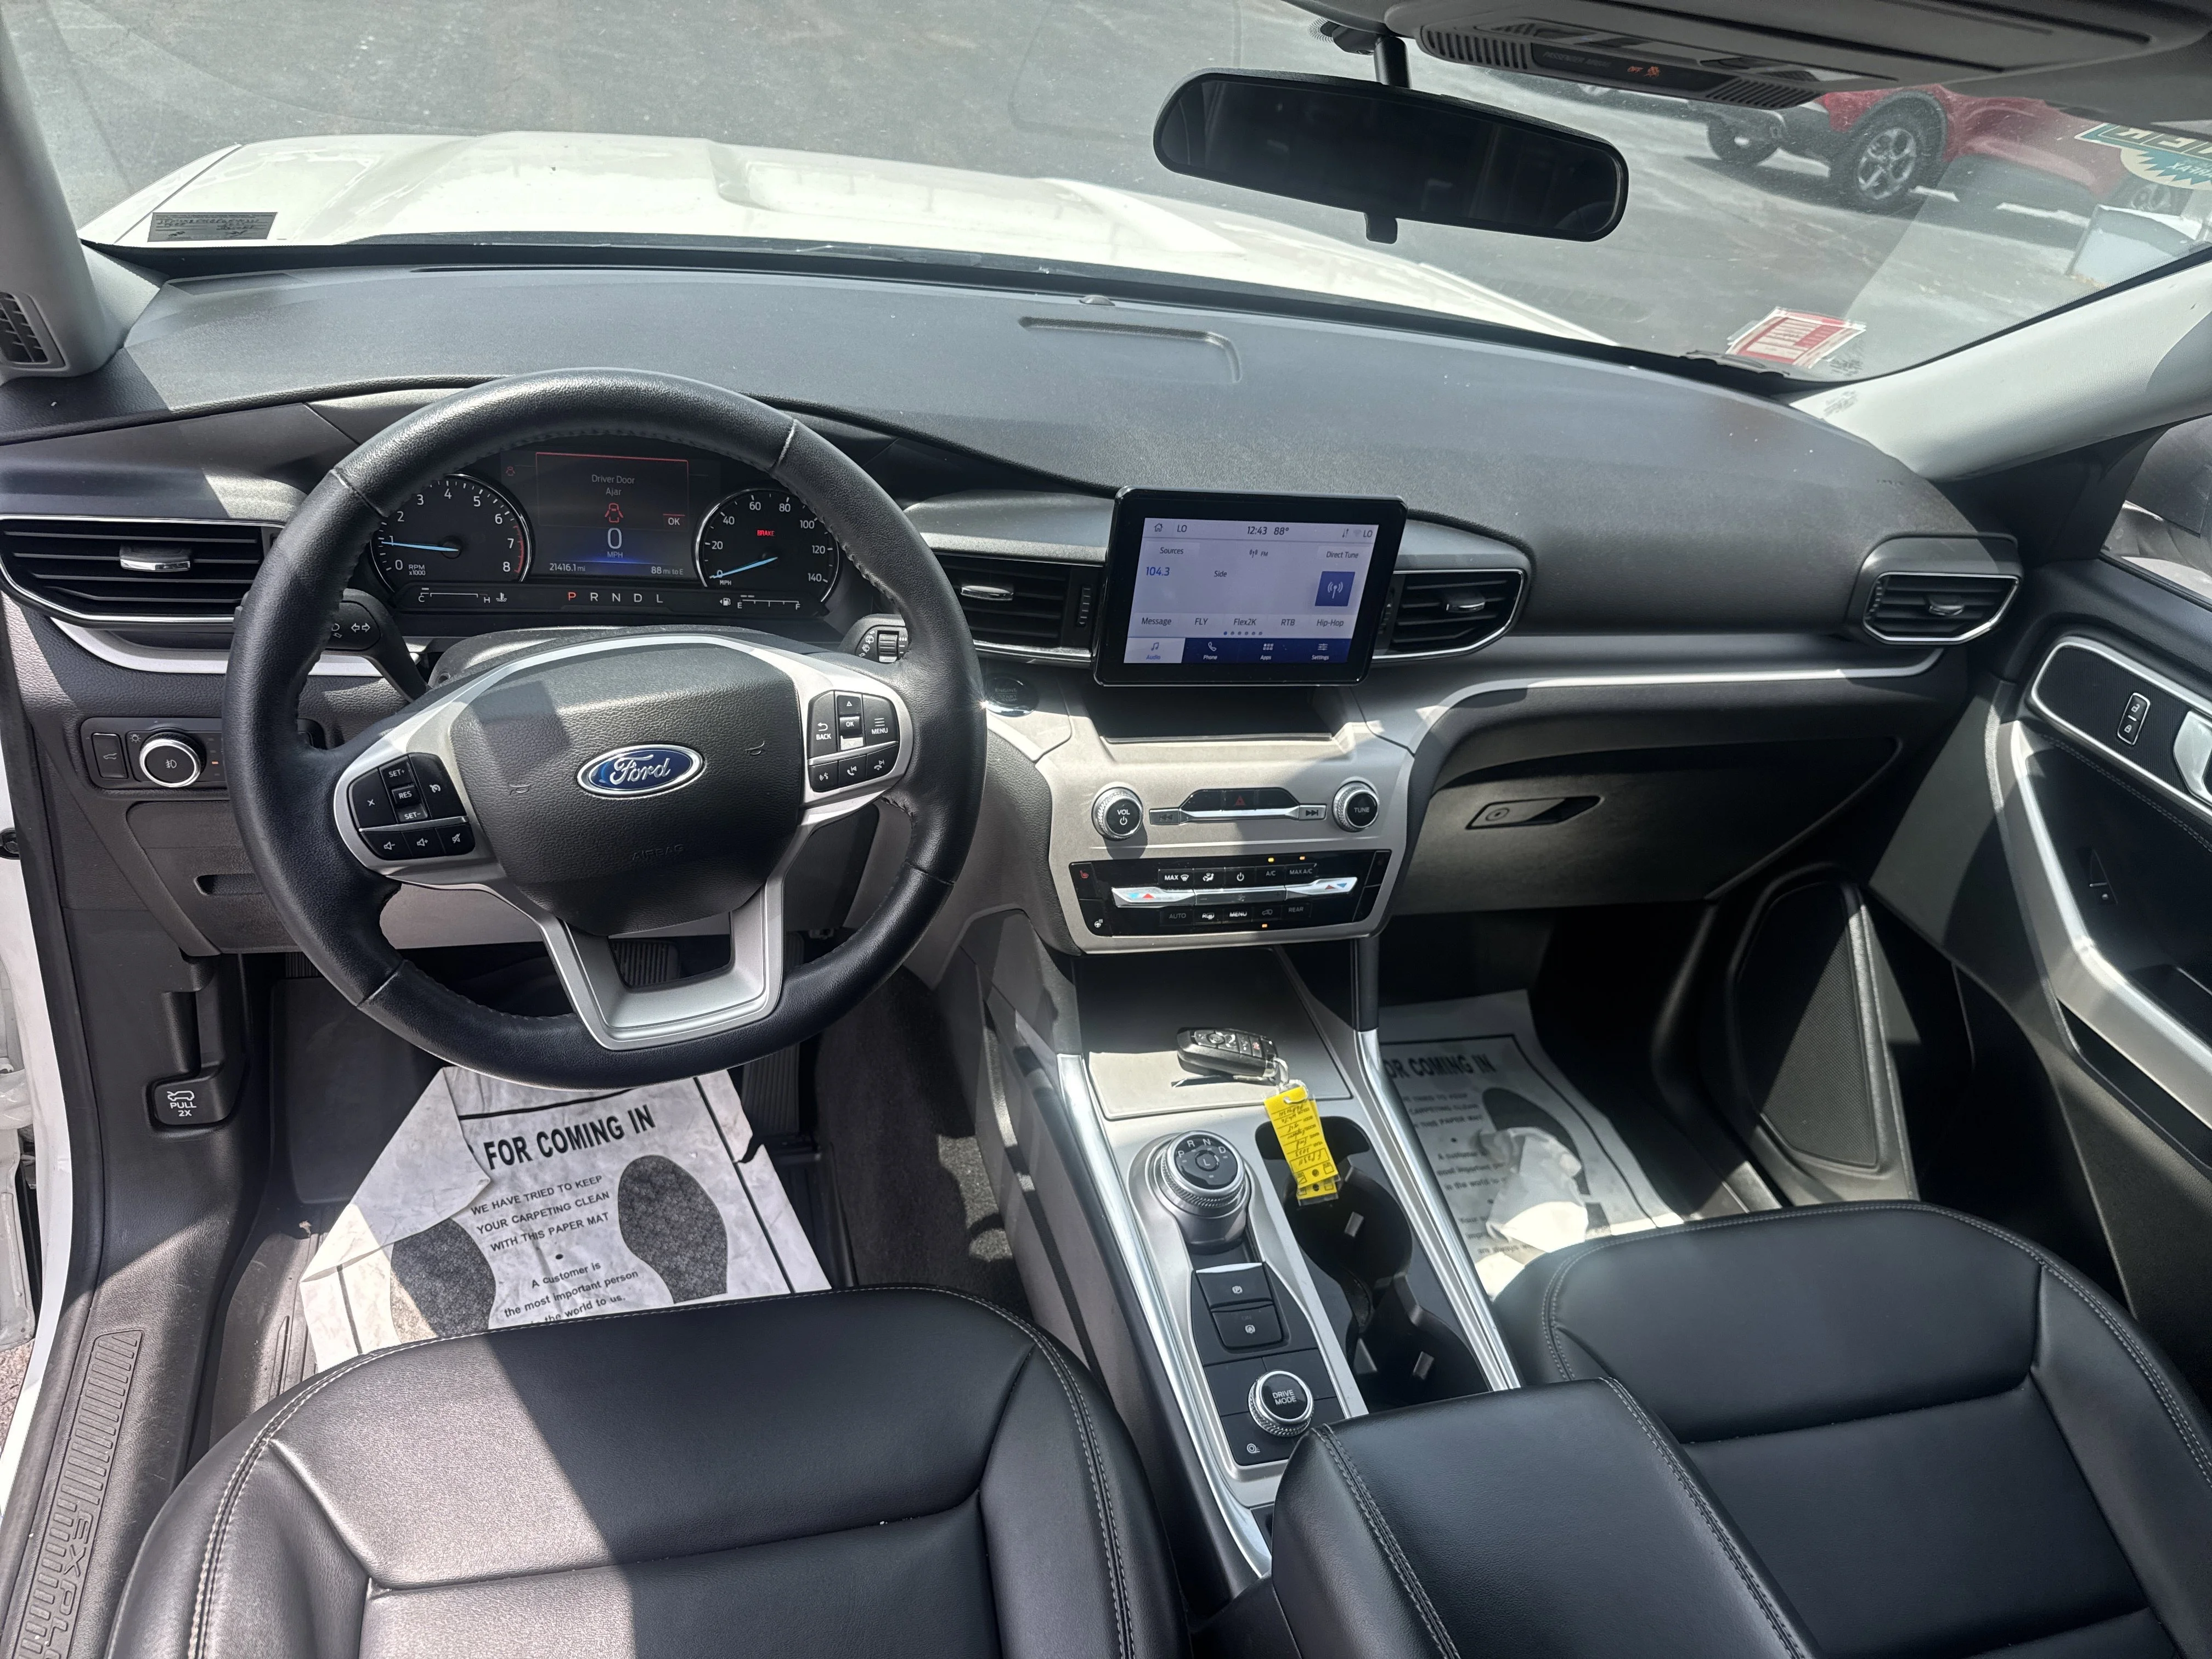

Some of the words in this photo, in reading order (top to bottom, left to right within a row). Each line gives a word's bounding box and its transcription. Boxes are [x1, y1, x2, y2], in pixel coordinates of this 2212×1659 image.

[592, 475, 614, 483] Driver
[617, 476, 635, 484] Door
[444, 488, 452, 499] 4
[606, 487, 622, 496] Ajar
[417, 494, 424, 505] 3
[473, 496, 481, 507] 5
[749, 502, 761, 511] 60
[779, 504, 791, 512] 80
[397, 511, 404, 522] 2
[495, 514, 503, 524] 6
[668, 517, 680, 526] OK
[723, 516, 735, 525] 40
[800, 520, 815, 529] 100
[1177, 524, 1187, 533] LO
[1247, 526, 1267, 535] 12:43
[507, 538, 514, 549] 7
[607, 528, 622, 549] 0
[712, 541, 723, 550] 20
[812, 545, 826, 554] 120
[395, 560, 403, 570] 0
[503, 562, 510, 572] 8
[549, 563, 576, 572] 21416.1
[651, 566, 662, 574] 88
[716, 569, 723, 578] 0
[1146, 566, 1170, 576] 104.3
[808, 573, 822, 582] 140
[568, 592, 576, 601] P
[590, 592, 599, 601] R
[612, 593, 620, 602] N
[634, 594, 642, 602] D
[656, 594, 663, 603] L
[1142, 617, 1172, 626] Message
[1316, 619, 1344, 628] Hip-Hop
[609, 754, 670, 785] Ford
[398, 791, 413, 799] RES
[170, 1101, 197, 1109] PULL
[483, 1135, 533, 1170] FOR
[536, 1115, 625, 1158] COMING
[627, 1104, 656, 1135] IN
[1178, 1150, 1184, 1158] P
[471, 1204, 489, 1216] WE
[492, 1195, 522, 1210] HAVE
[523, 1187, 555, 1203] TRIED
[557, 1182, 572, 1194] TO
[575, 1175, 602, 1189] KEEP
[476, 1220, 509, 1235] YOUR
[511, 1203, 572, 1224] CARPETING
[574, 1191, 610, 1208] CLEAN
[490, 1236, 518, 1252] WITH
[521, 1230, 545, 1243] THIS
[548, 1219, 584, 1235] PAPER
[586, 1212, 610, 1227] MAT
[532, 1279, 540, 1289] A
[543, 1266, 589, 1284] customer
[591, 1262, 601, 1271] is
[504, 1307, 521, 1318] the
[524, 1296, 551, 1312] most
[553, 1282, 602, 1302] important
[604, 1270, 639, 1288] person
[545, 1312, 562, 1323] the
[565, 1301, 593, 1318] world
[596, 1297, 607, 1307] to
[609, 1293, 627, 1303] us.
[1272, 1390, 1295, 1398] DRIVE
[1274, 1396, 1297, 1406] MODE
